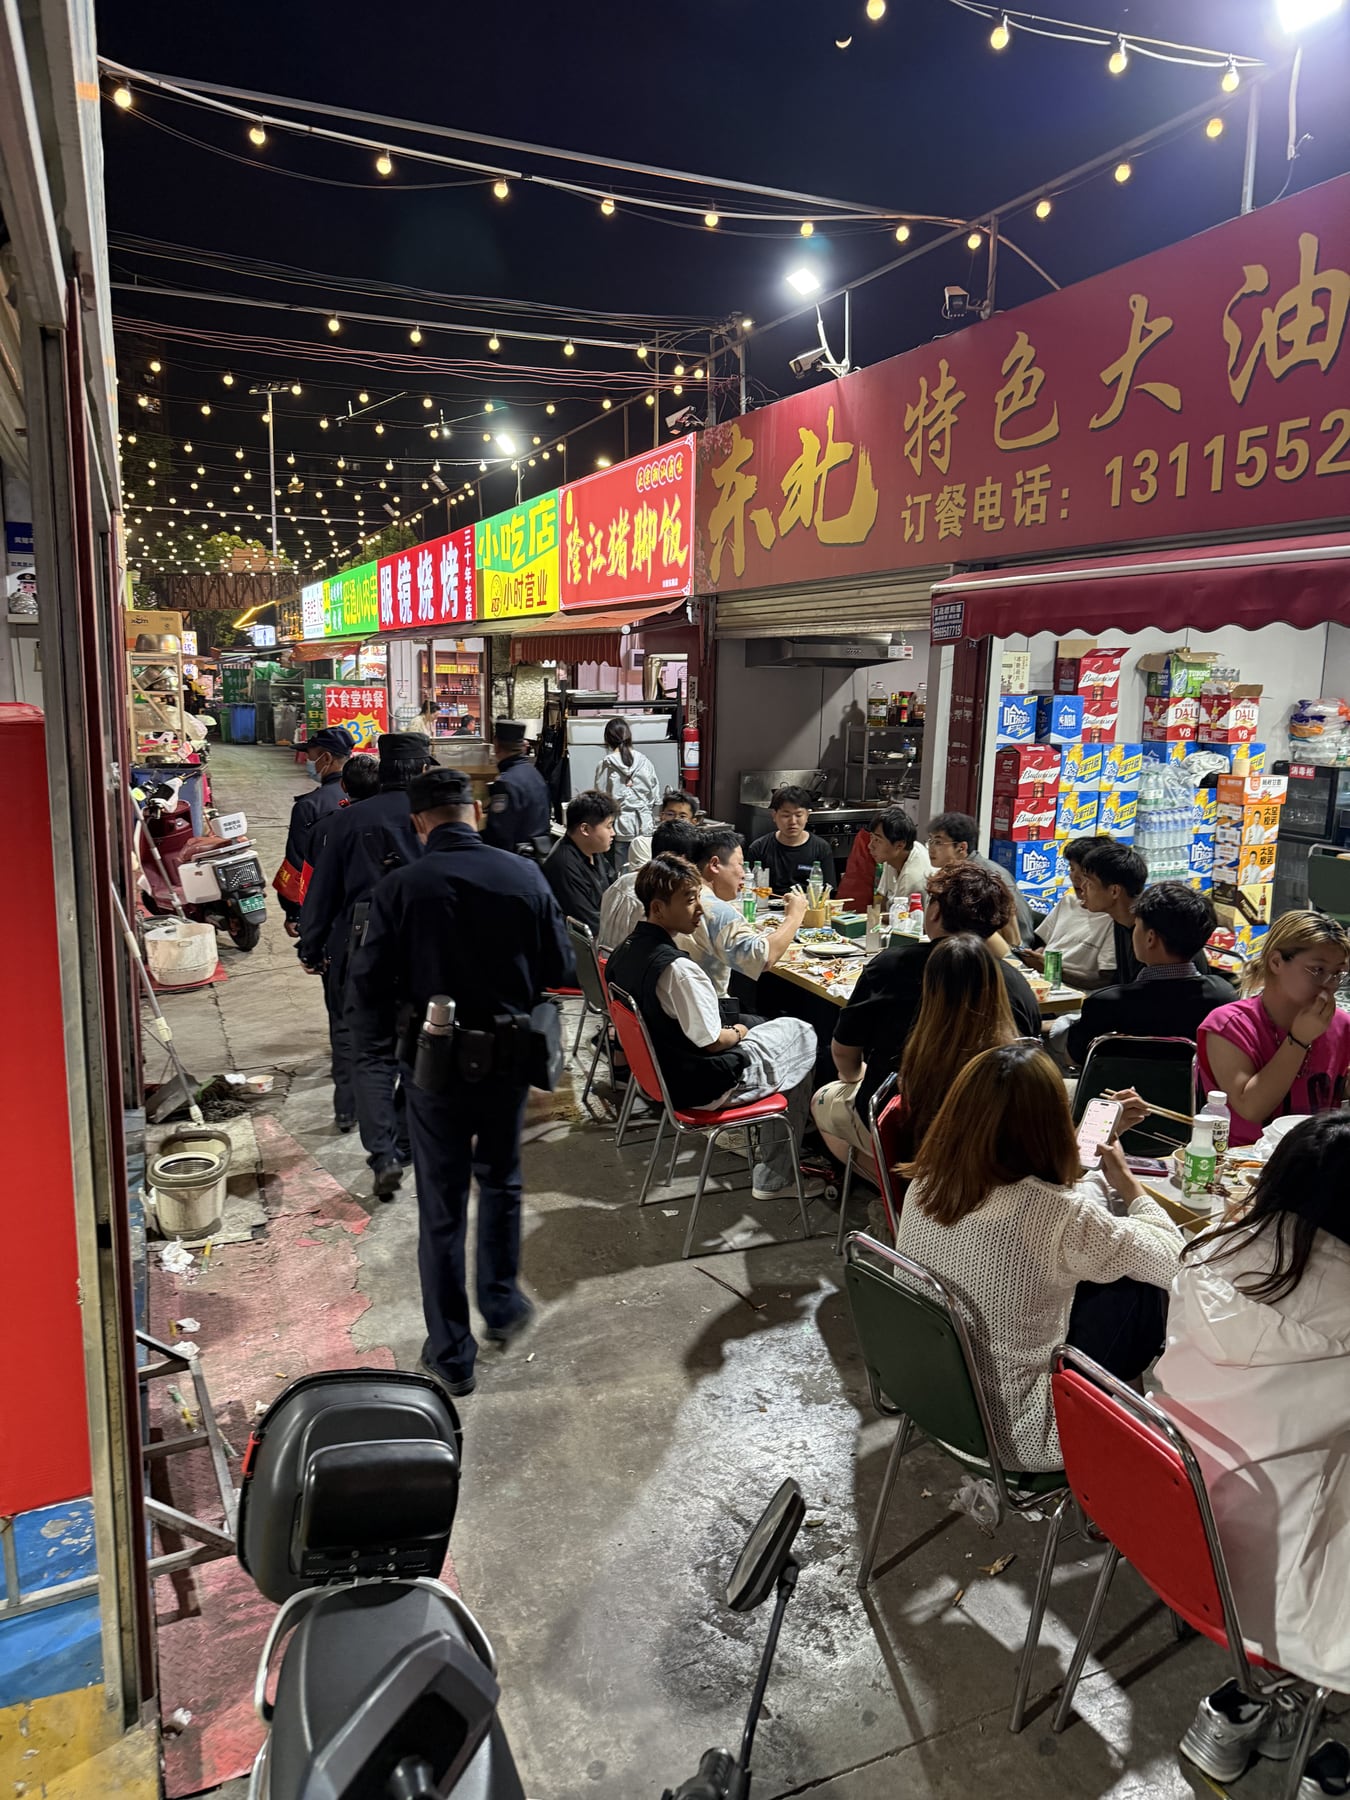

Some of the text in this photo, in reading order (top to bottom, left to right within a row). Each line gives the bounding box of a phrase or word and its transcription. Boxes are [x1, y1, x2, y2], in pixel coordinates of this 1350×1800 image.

[1105, 408, 1350, 507] 1311552
[707, 406, 878, 583] 东北
[478, 497, 555, 570] 小吃店
[566, 493, 688, 585] 隆江猪脚饭
[380, 541, 458, 626] 眼镜烧烤
[464, 529, 472, 620] 三十年老店
[327, 690, 384, 708] 大食堂快餐
[1179, 728, 1191, 737] V8
[1237, 729, 1248, 739] V8
[1022, 770, 1057, 780] Budweiser
[1290, 766, 1314, 777] 消毒柜
[1016, 814, 1052, 823] Budweiser
